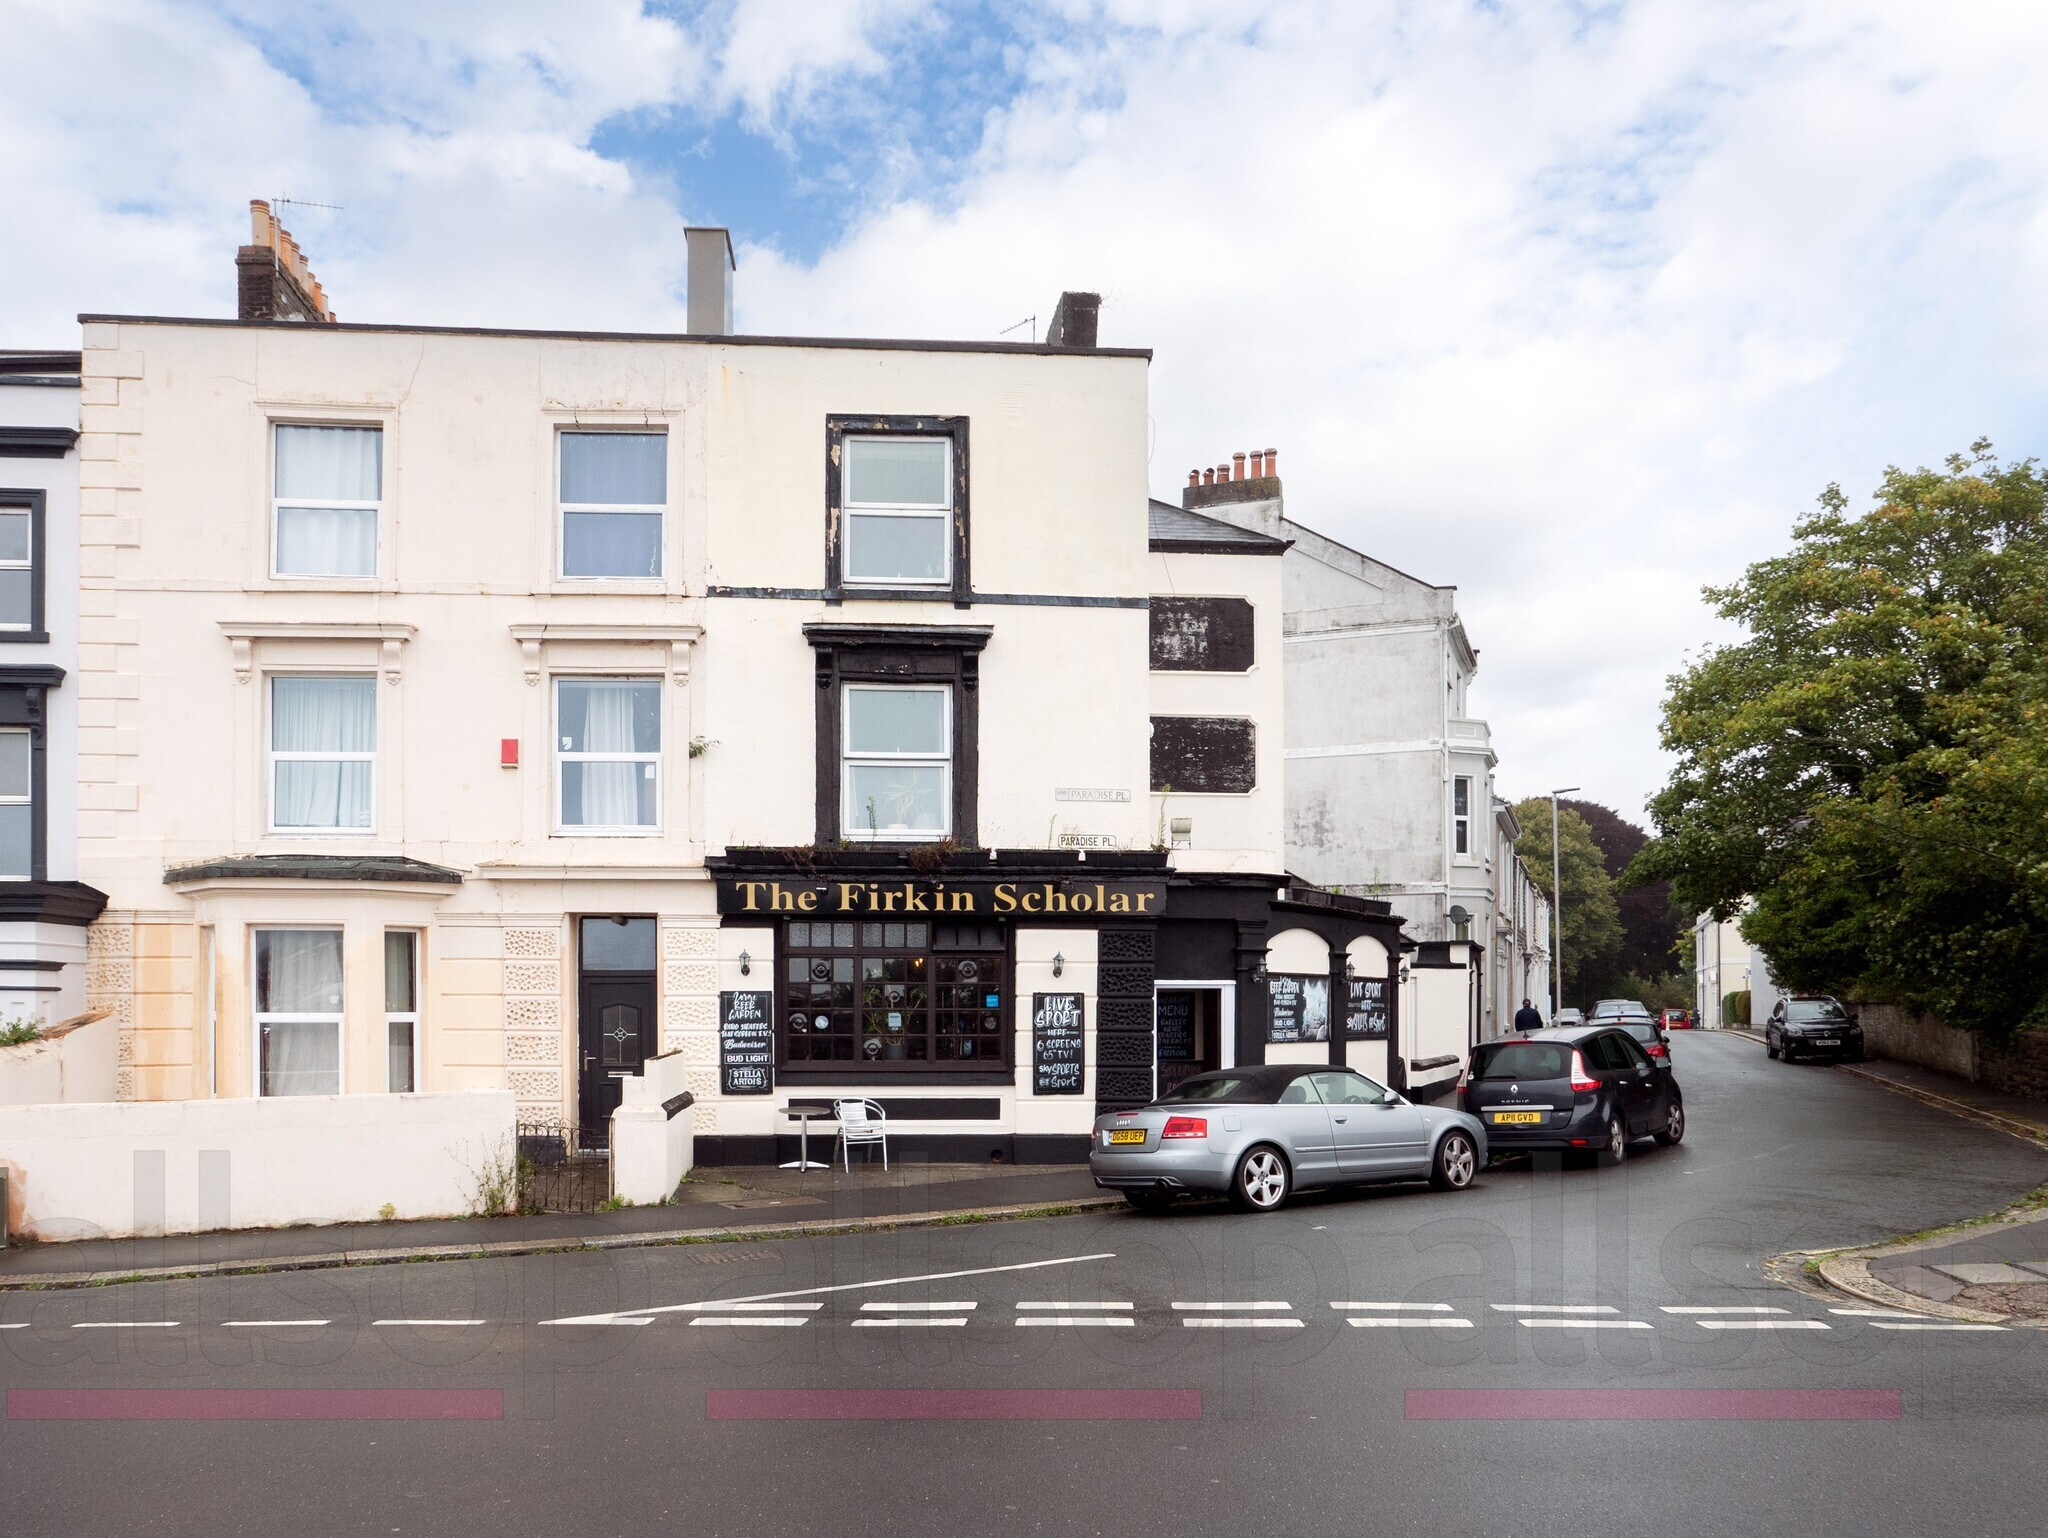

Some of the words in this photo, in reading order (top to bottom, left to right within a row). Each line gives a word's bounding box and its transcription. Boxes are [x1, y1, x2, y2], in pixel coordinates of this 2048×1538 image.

[1071, 790, 1113, 800] PARADISE
[1061, 836, 1098, 846] PARADISE
[736, 882, 818, 911] The
[837, 882, 975, 912] Firkin
[993, 883, 1156, 912] Scholar
[734, 1001, 755, 1010] BEER
[1044, 996, 1075, 1011] LIVE
[728, 1009, 761, 1020] GARDEN
[1158, 1005, 1188, 1016] MENU
[1035, 1009, 1081, 1027] SPORT
[724, 1039, 767, 1049] Budweiser
[1037, 1039, 1044, 1051] 6
[1046, 1039, 1081, 1048] SCREENS
[733, 1070, 762, 1078] STELLA
[1051, 1076, 1077, 1087] Sport
[1501, 1114, 1516, 1122] AP11
[1518, 1113, 1534, 1121] GVD
[1130, 1131, 1144, 1140] UEP
